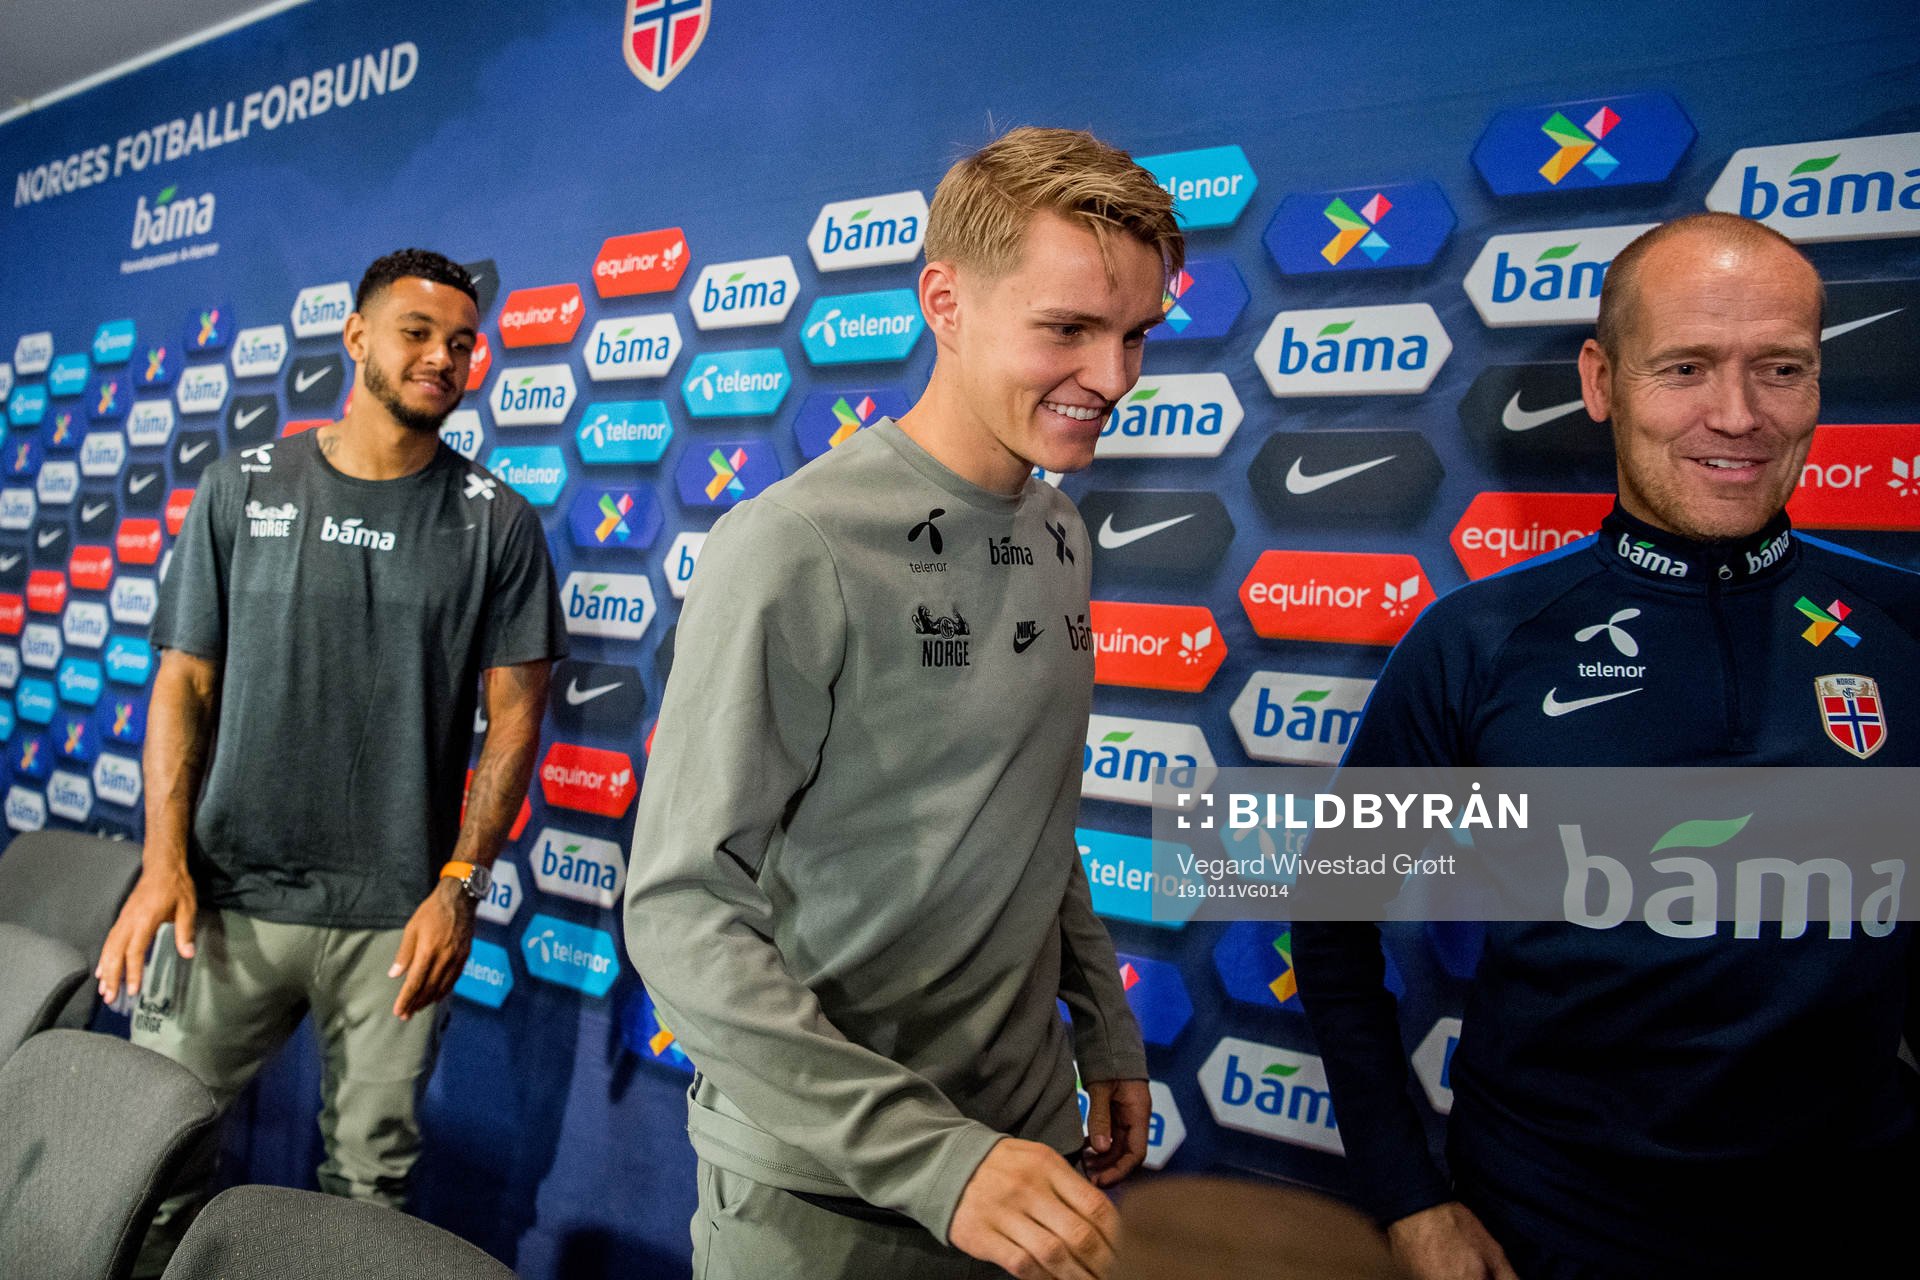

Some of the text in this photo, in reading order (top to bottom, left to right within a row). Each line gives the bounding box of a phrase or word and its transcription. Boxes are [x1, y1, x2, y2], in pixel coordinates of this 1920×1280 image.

[14, 41, 418, 207] NORGES FOTBALLFORBUND
[131, 191, 215, 251] bama
[823, 215, 919, 254] bama
[596, 253, 658, 278] equinor
[1492, 252, 1612, 303] bam
[704, 278, 786, 312] bama
[300, 300, 346, 325] bama
[502, 307, 556, 330] equinor
[840, 313, 915, 338] telenor
[596, 333, 670, 364] bama
[1278, 327, 1428, 375] bama
[500, 382, 566, 411] bama
[716, 371, 782, 393] telenor
[606, 420, 666, 441] telenor
[508, 465, 560, 484] telenor
[250, 520, 291, 537] NORGE
[320, 516, 396, 551] bama
[989, 538, 1033, 565] bama
[1618, 533, 1688, 577] bama
[1745, 530, 1790, 574] bama
[910, 561, 947, 574] telenor
[569, 584, 644, 623] bama
[1249, 579, 1371, 611] equinor
[1016, 621, 1036, 639] NIKE
[922, 640, 970, 667] NORGE
[1578, 662, 1646, 678] telenor
[1836, 678, 1856, 686] NORGE
[1253, 688, 1363, 744] bam
[543, 764, 605, 789] equinor
[541, 841, 617, 890] bama
[1558, 824, 1906, 940] bama
[552, 940, 611, 975] telenor
[1222, 1054, 1336, 1130] bam
